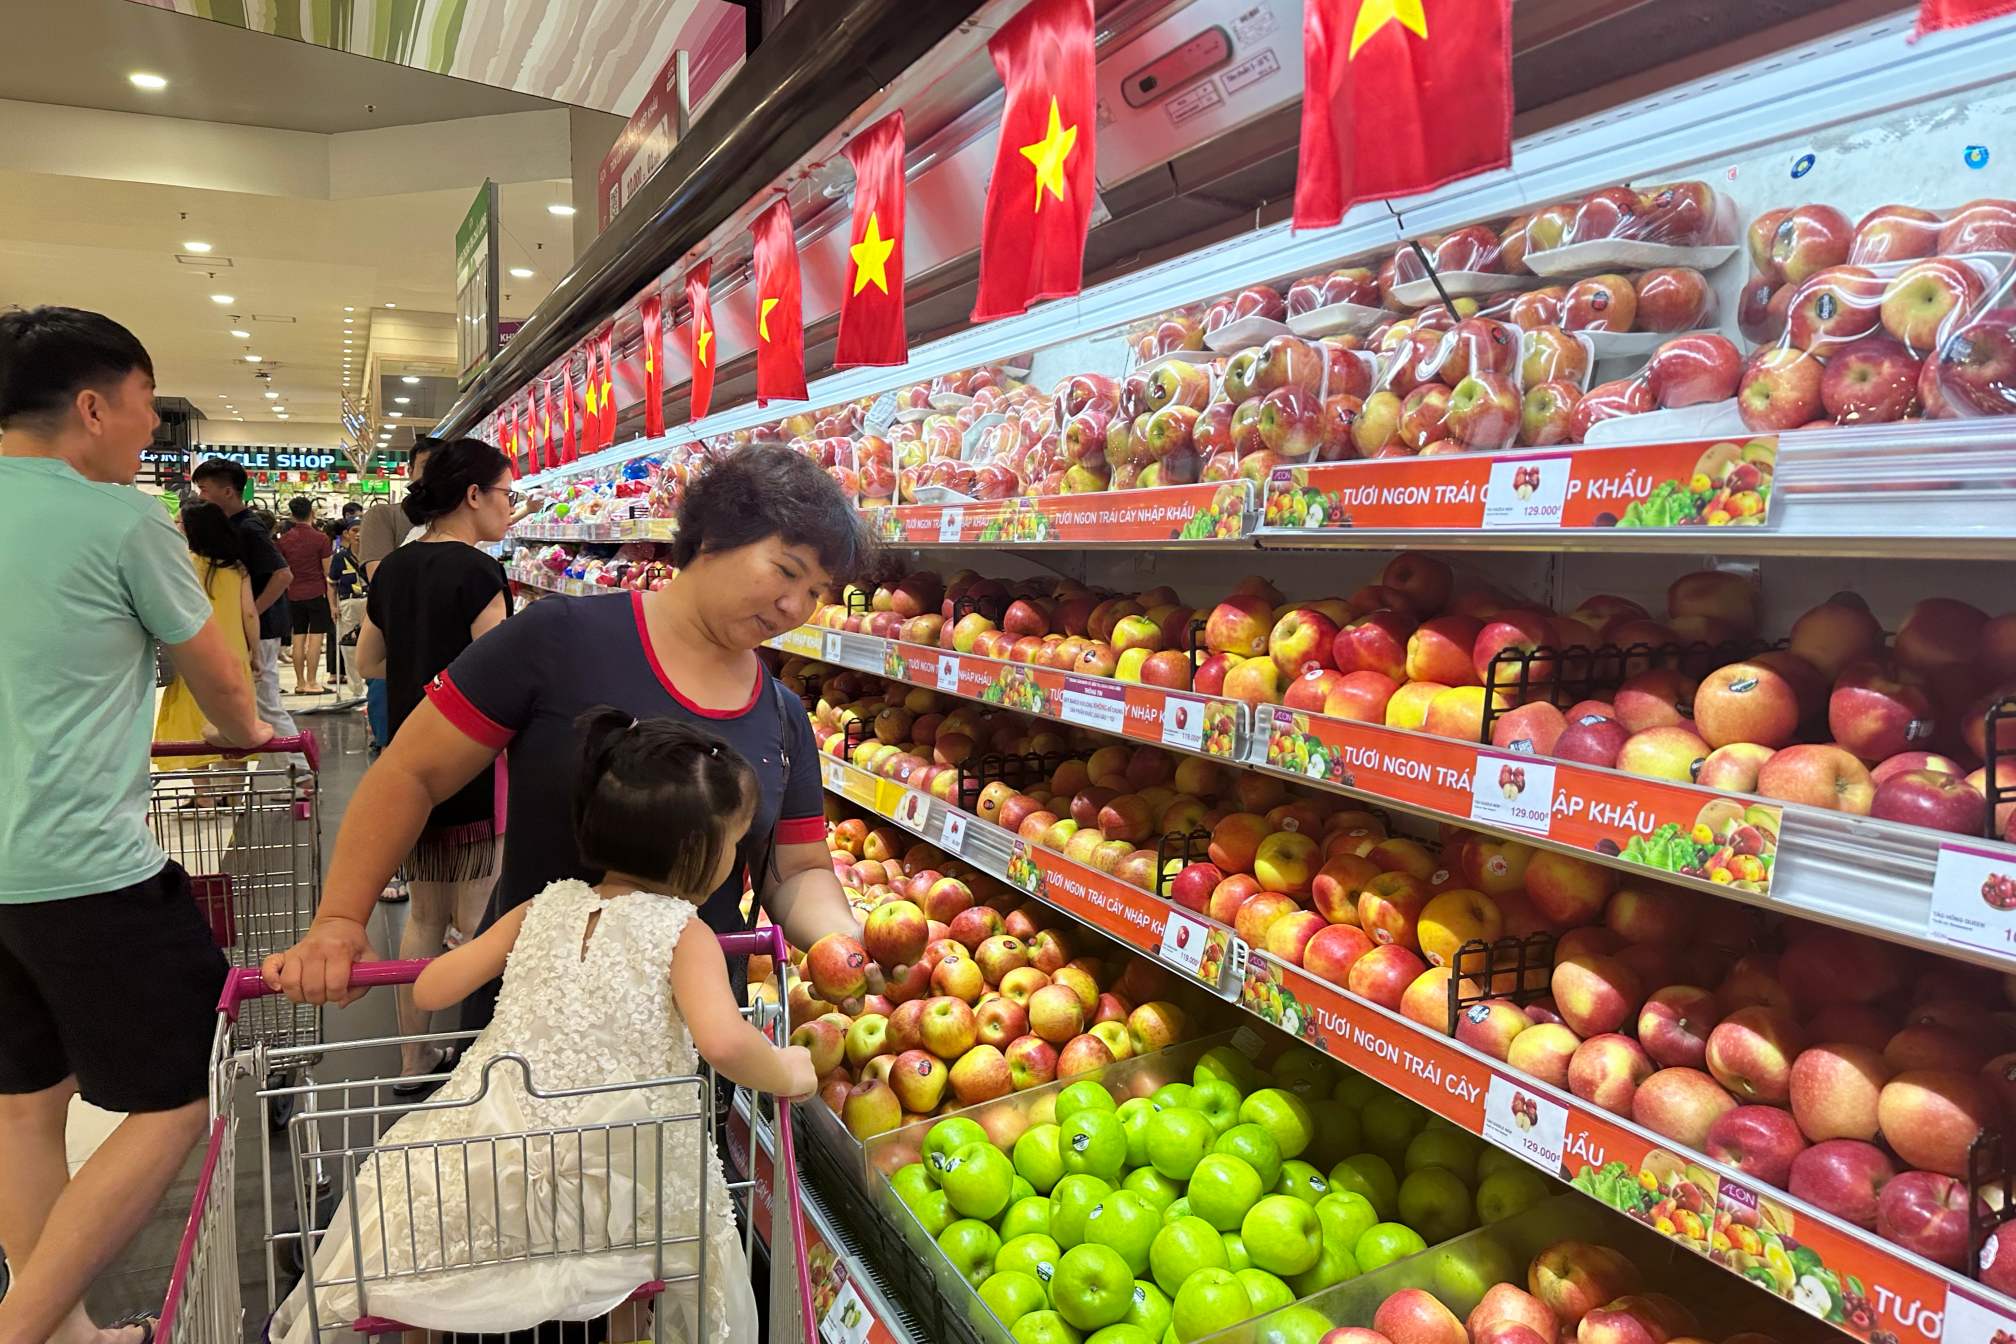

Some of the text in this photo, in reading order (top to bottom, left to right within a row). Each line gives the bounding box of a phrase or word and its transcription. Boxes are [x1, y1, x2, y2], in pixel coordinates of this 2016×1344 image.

[276, 454, 335, 468] SHOP
[1343, 485, 1378, 505] TƯƠI
[1381, 487, 1431, 504] NGON
[1434, 480, 1476, 504] TRÁI
[1587, 469, 1653, 500] KHẨU
[1074, 511, 1096, 524] NGON
[1131, 704, 1158, 724] NHẬP
[1345, 746, 1379, 770] TƯƠI
[1383, 757, 1431, 782] NGON
[1588, 800, 1656, 834] KHẨU
[1046, 870, 1165, 935] TƯƠI NGON TRÁI CÂY NHẬP KH
[1317, 1008, 1351, 1036] TƯƠI
[1354, 1027, 1399, 1064] NGON
[1403, 1051, 1441, 1086] TRÁI
[1445, 1074, 1481, 1104] CÂY
[1563, 1131, 1604, 1167] HẨU
[1874, 1285, 1944, 1339] TƯƠ
